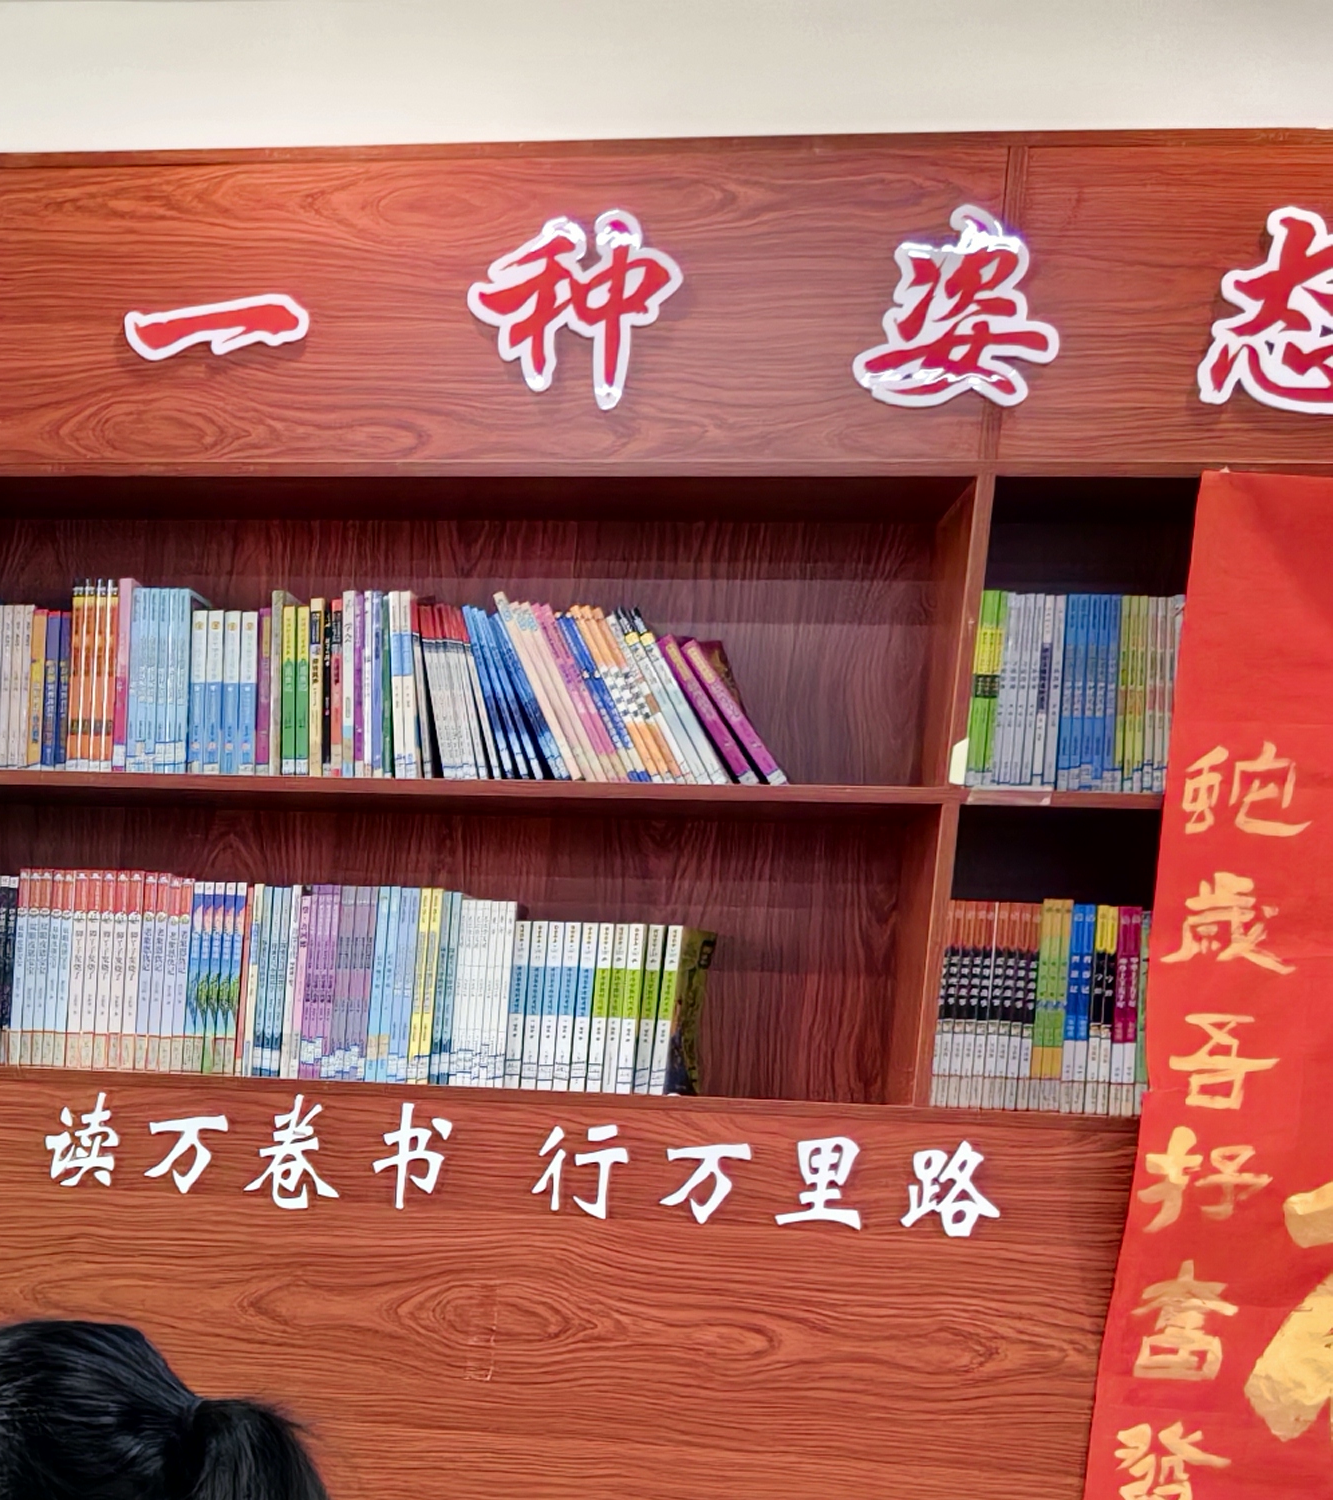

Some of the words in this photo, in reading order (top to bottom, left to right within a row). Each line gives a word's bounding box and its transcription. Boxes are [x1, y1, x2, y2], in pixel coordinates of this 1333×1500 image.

[45, 1093, 451, 1210] 读万卷书
[532, 1124, 1000, 1238] 行万里路
